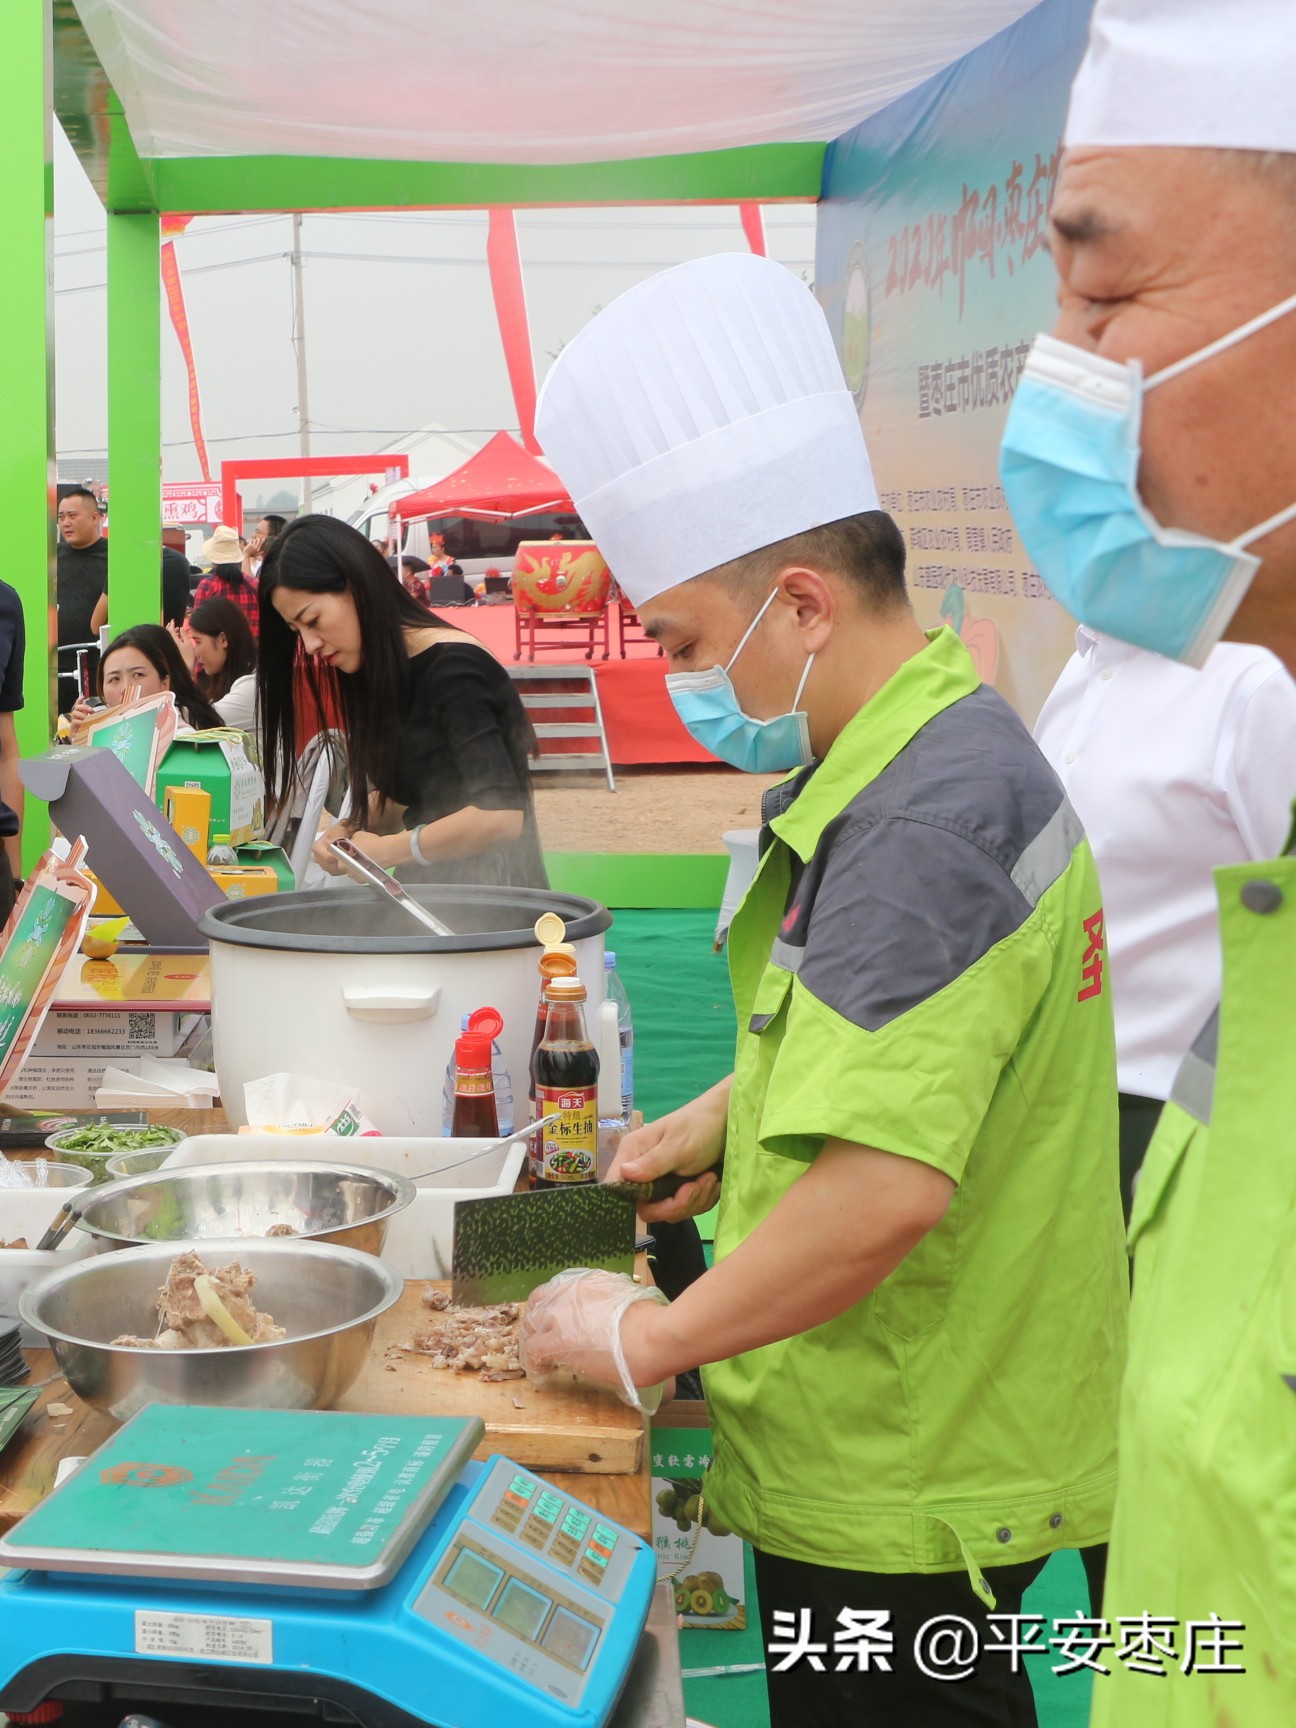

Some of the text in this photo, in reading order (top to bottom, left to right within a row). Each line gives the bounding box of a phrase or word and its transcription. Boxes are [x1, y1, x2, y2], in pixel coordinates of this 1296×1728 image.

[560, 1097, 583, 1109] 海天
[547, 1120, 594, 1136] 金标生抽
[188, 1455, 277, 1507] KAIDA
[268, 1458, 335, 1510] 凯达衡器
